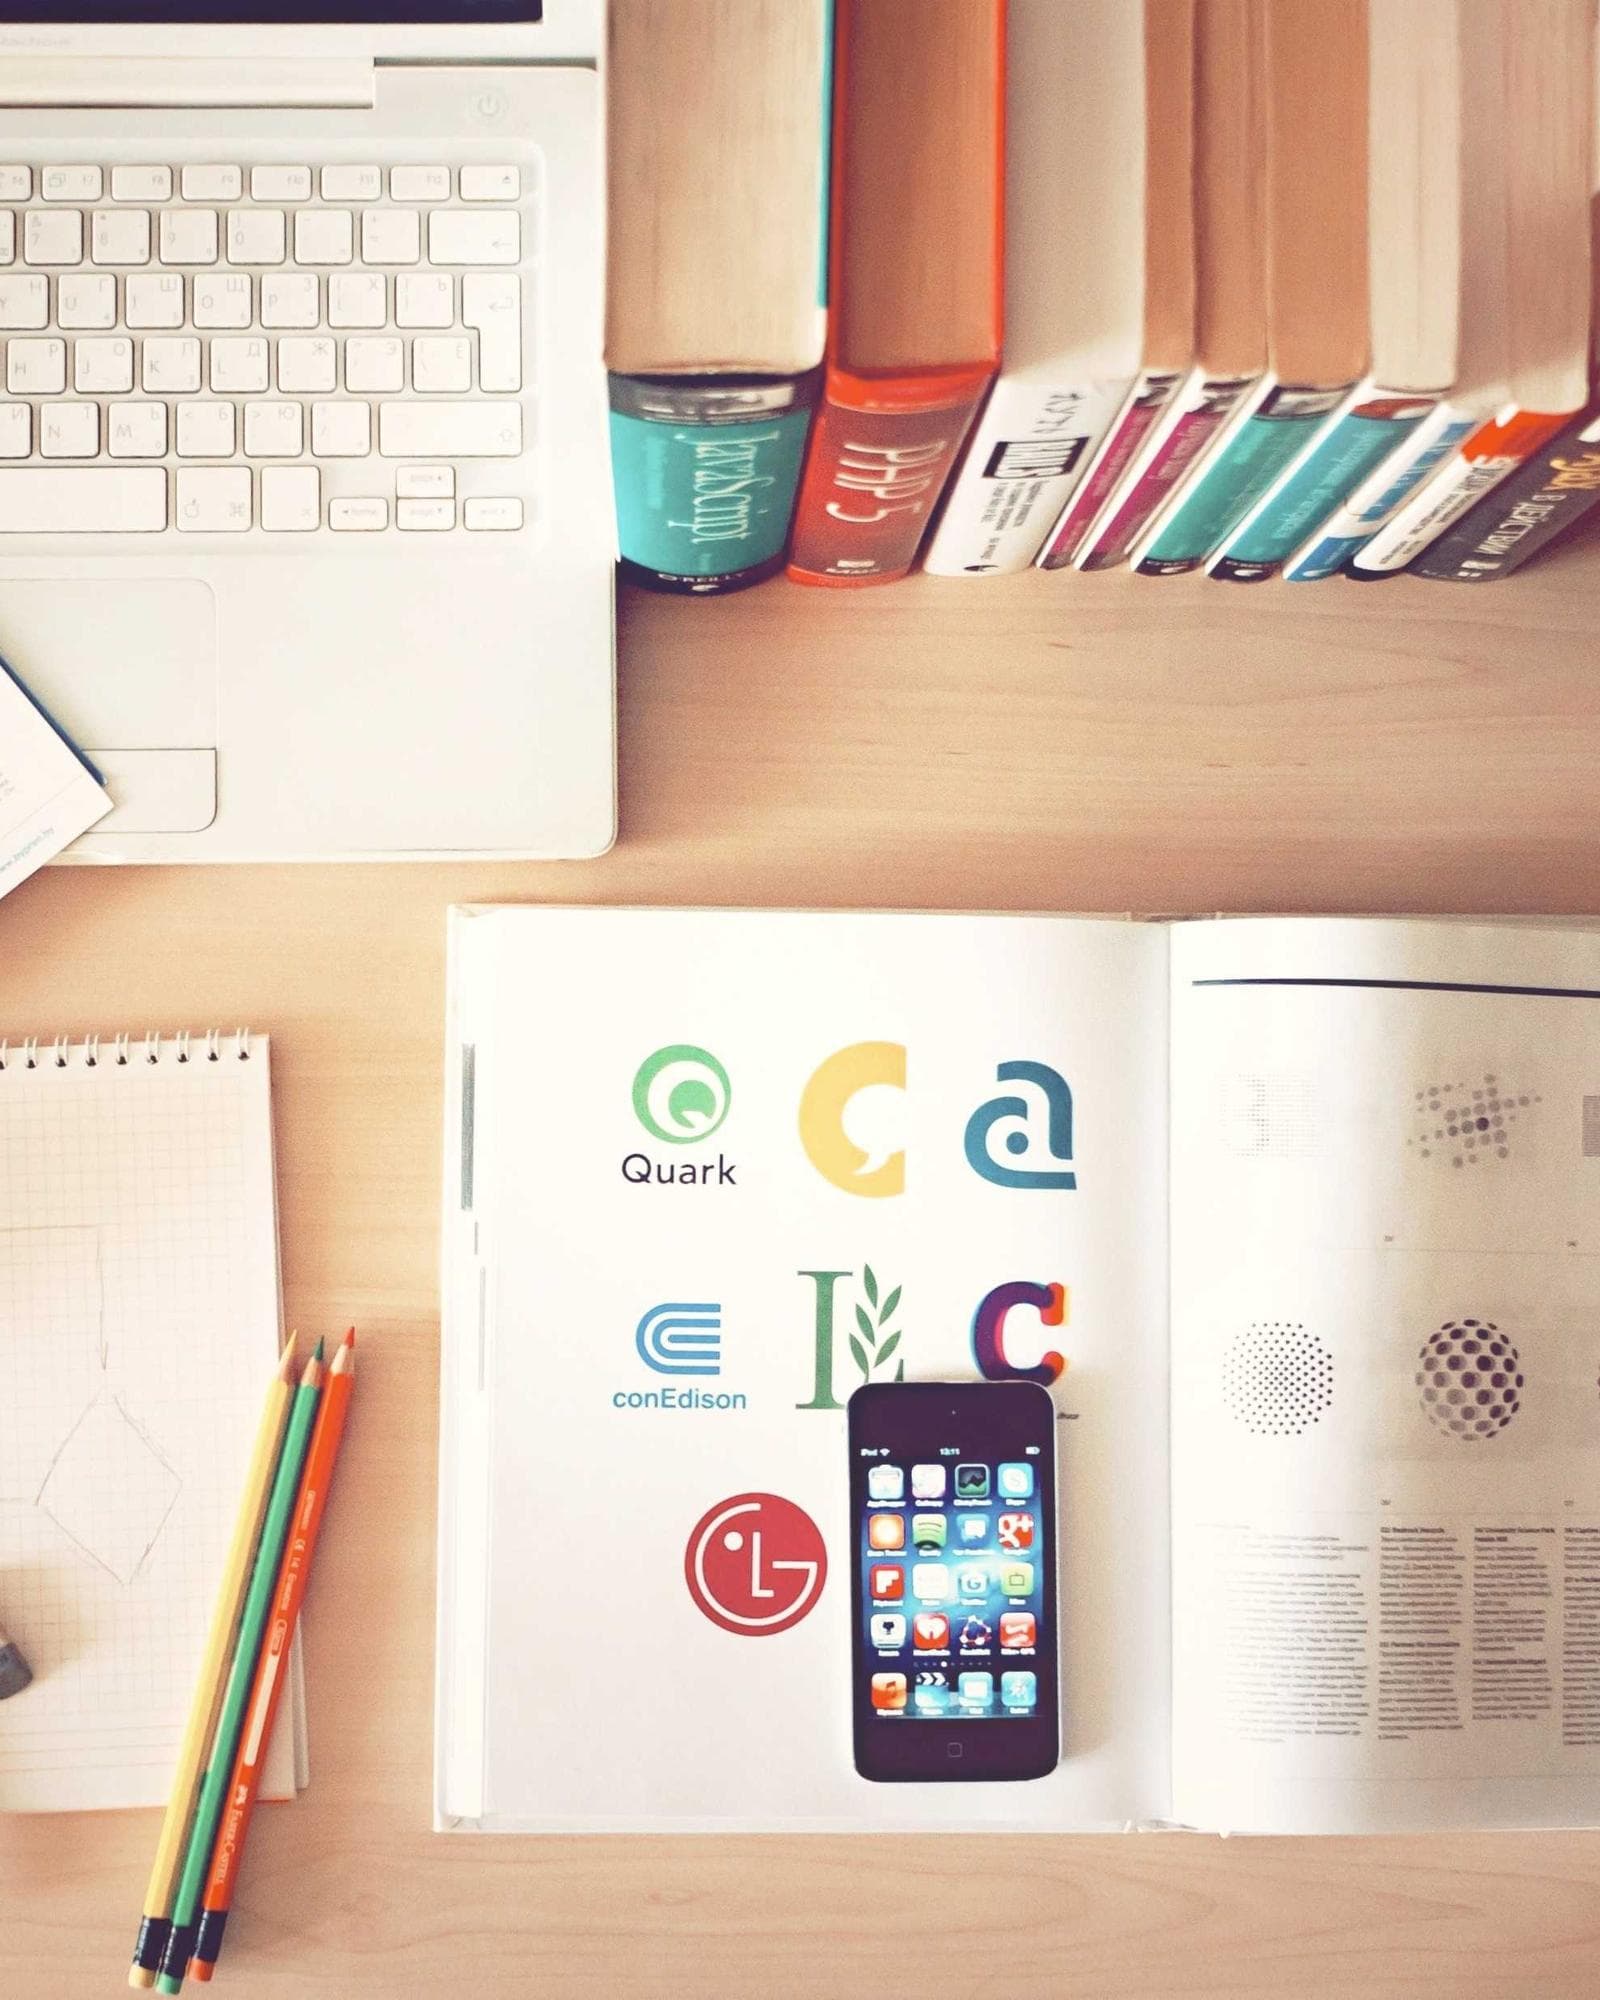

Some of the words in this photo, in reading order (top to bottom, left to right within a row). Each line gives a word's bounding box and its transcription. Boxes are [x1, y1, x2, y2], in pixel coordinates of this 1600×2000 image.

[668, 430, 781, 544] JavaScript
[621, 1153, 737, 1186] Quark
[612, 1389, 747, 1410] conEdison
